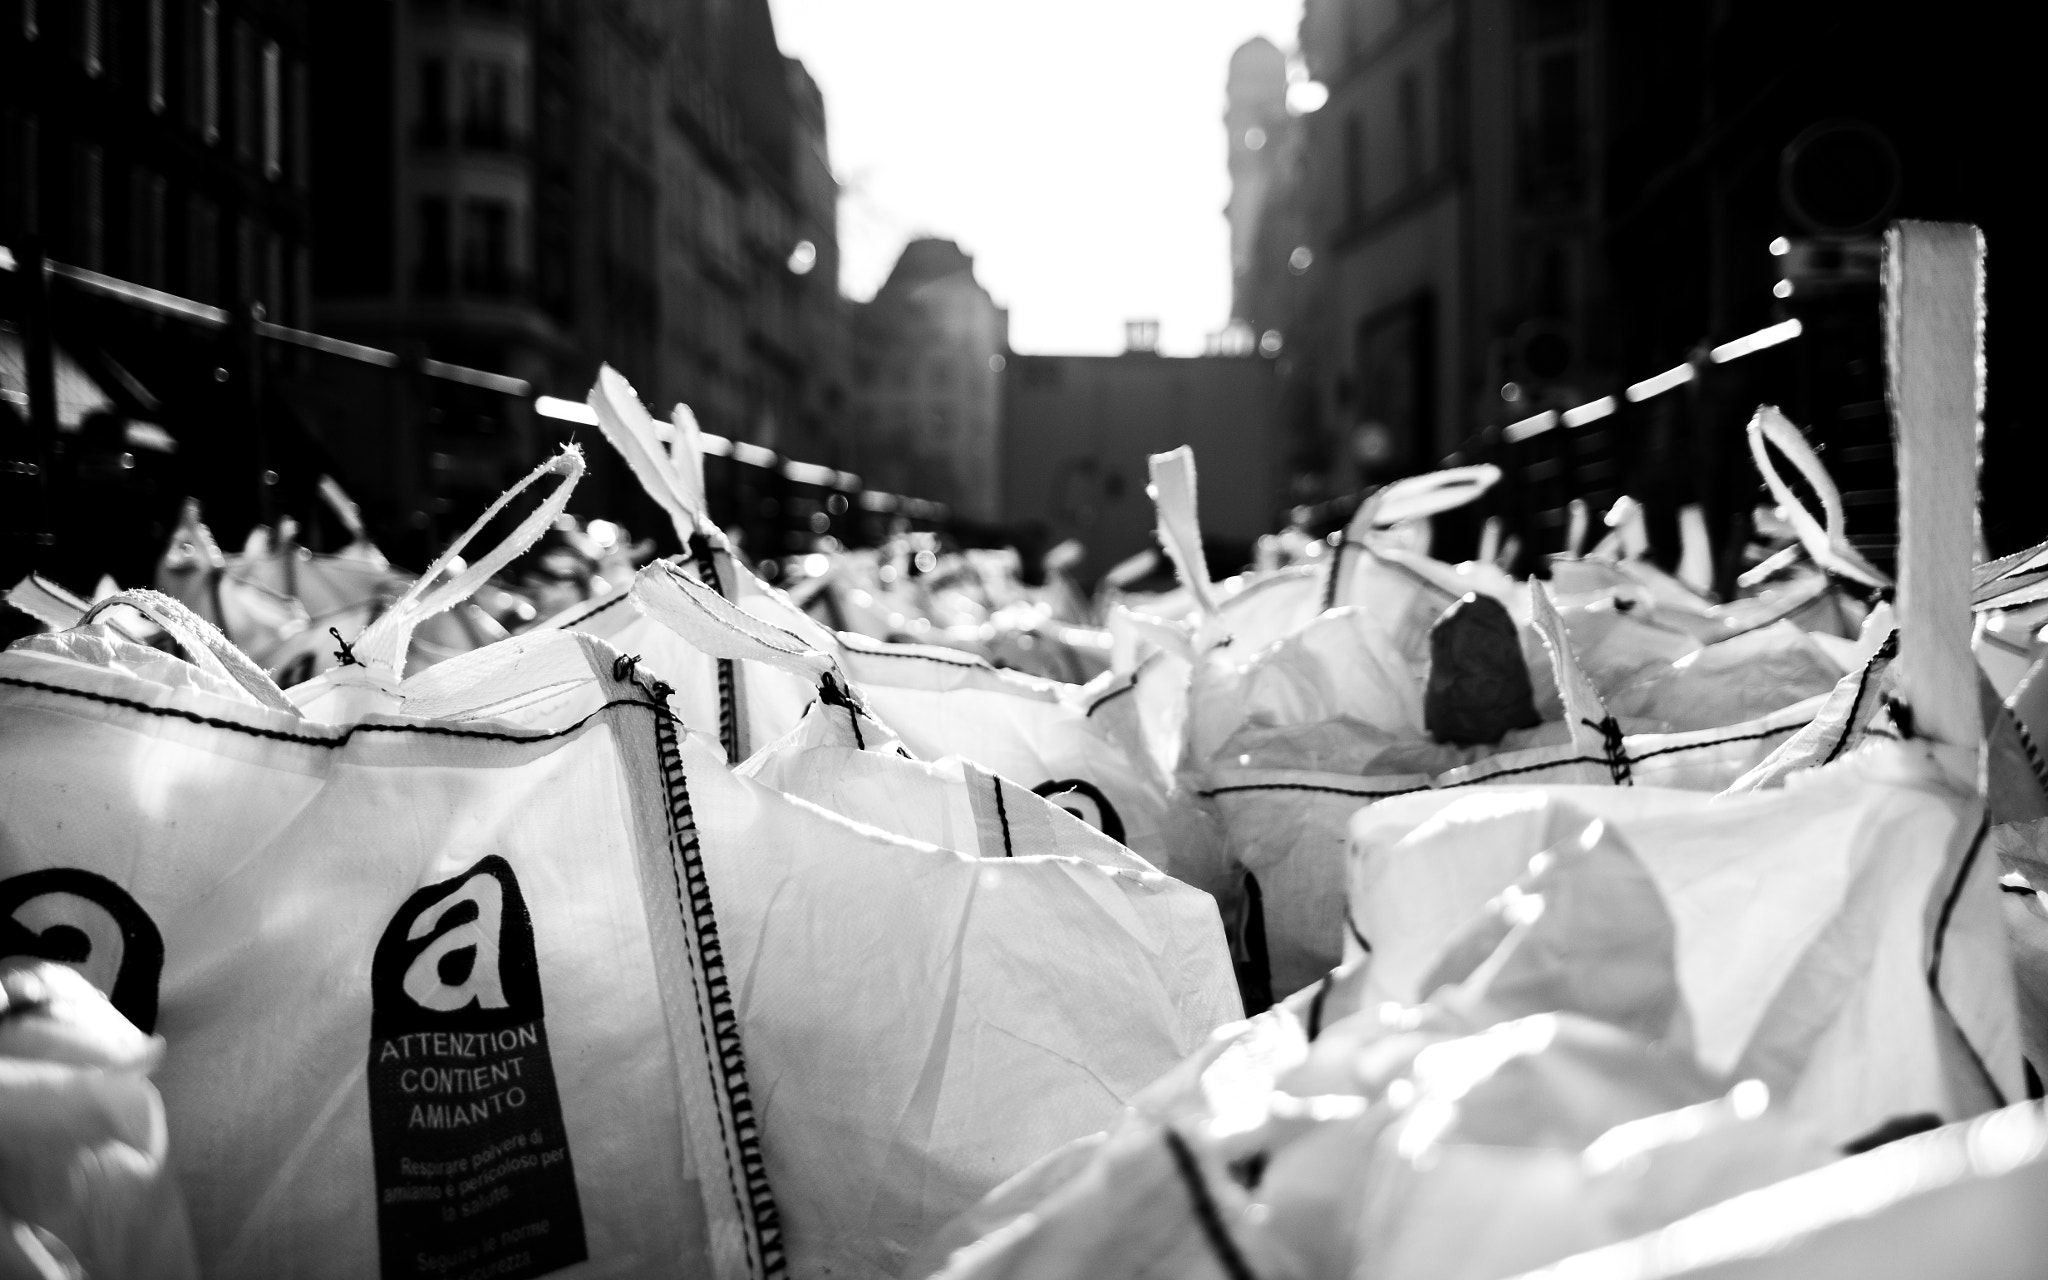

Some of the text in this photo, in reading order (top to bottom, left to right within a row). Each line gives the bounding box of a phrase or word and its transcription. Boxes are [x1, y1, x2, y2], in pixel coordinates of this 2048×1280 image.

[402, 872, 510, 1012] a
[379, 1023, 538, 1063] ATTENZTION
[400, 1056, 524, 1094] CONTIENT
[408, 1086, 526, 1129] AMIANTO
[400, 1128, 543, 1179] Respirare polvere di
[383, 1182, 442, 1204] amianto
[459, 1154, 538, 1197] pericoloso
[541, 1147, 566, 1169] per
[441, 1203, 457, 1222] la
[501, 1218, 550, 1246] norme
